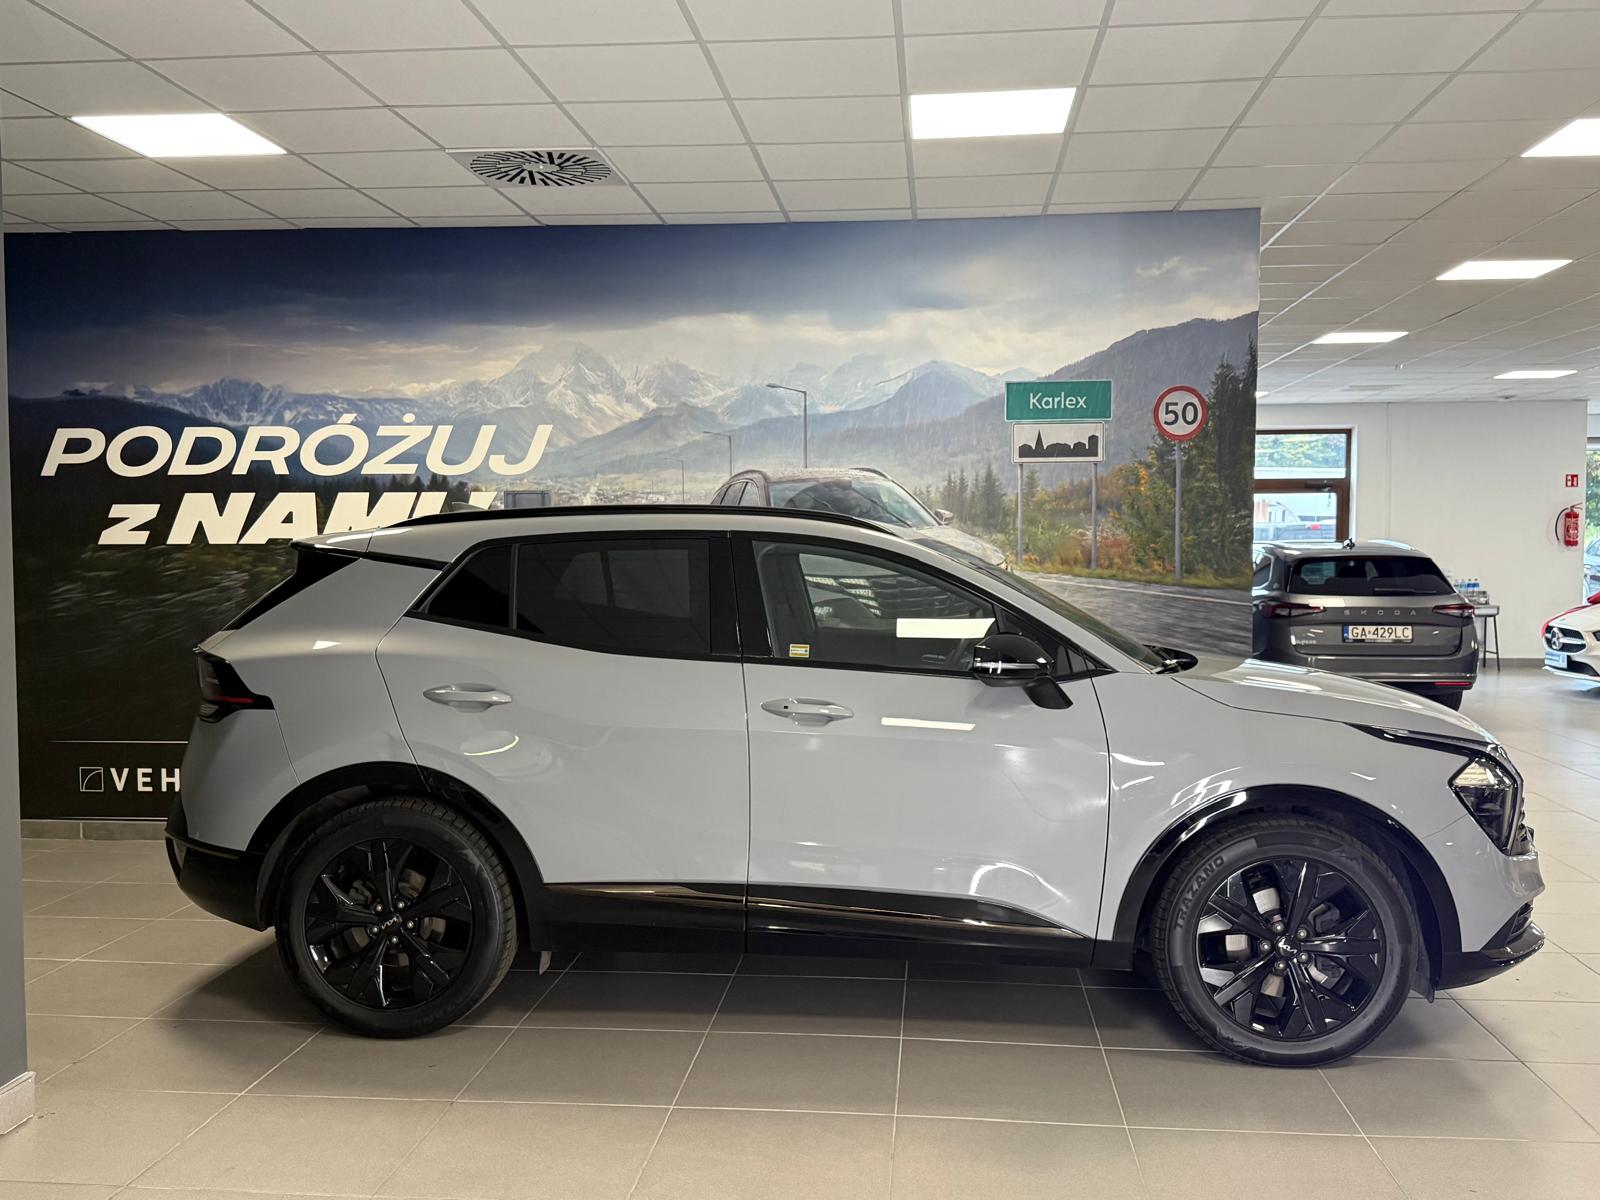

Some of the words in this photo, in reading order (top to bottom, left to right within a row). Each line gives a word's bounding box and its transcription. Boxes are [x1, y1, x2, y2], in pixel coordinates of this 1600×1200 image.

[1029, 391, 1087, 409] Karlex
[1163, 402, 1199, 426] 50
[40, 413, 554, 477] PODRÓŻUJ
[1351, 626, 1367, 639] GA
[1372, 626, 1410, 639] 429LC
[1175, 855, 1225, 930] TRAZANO
